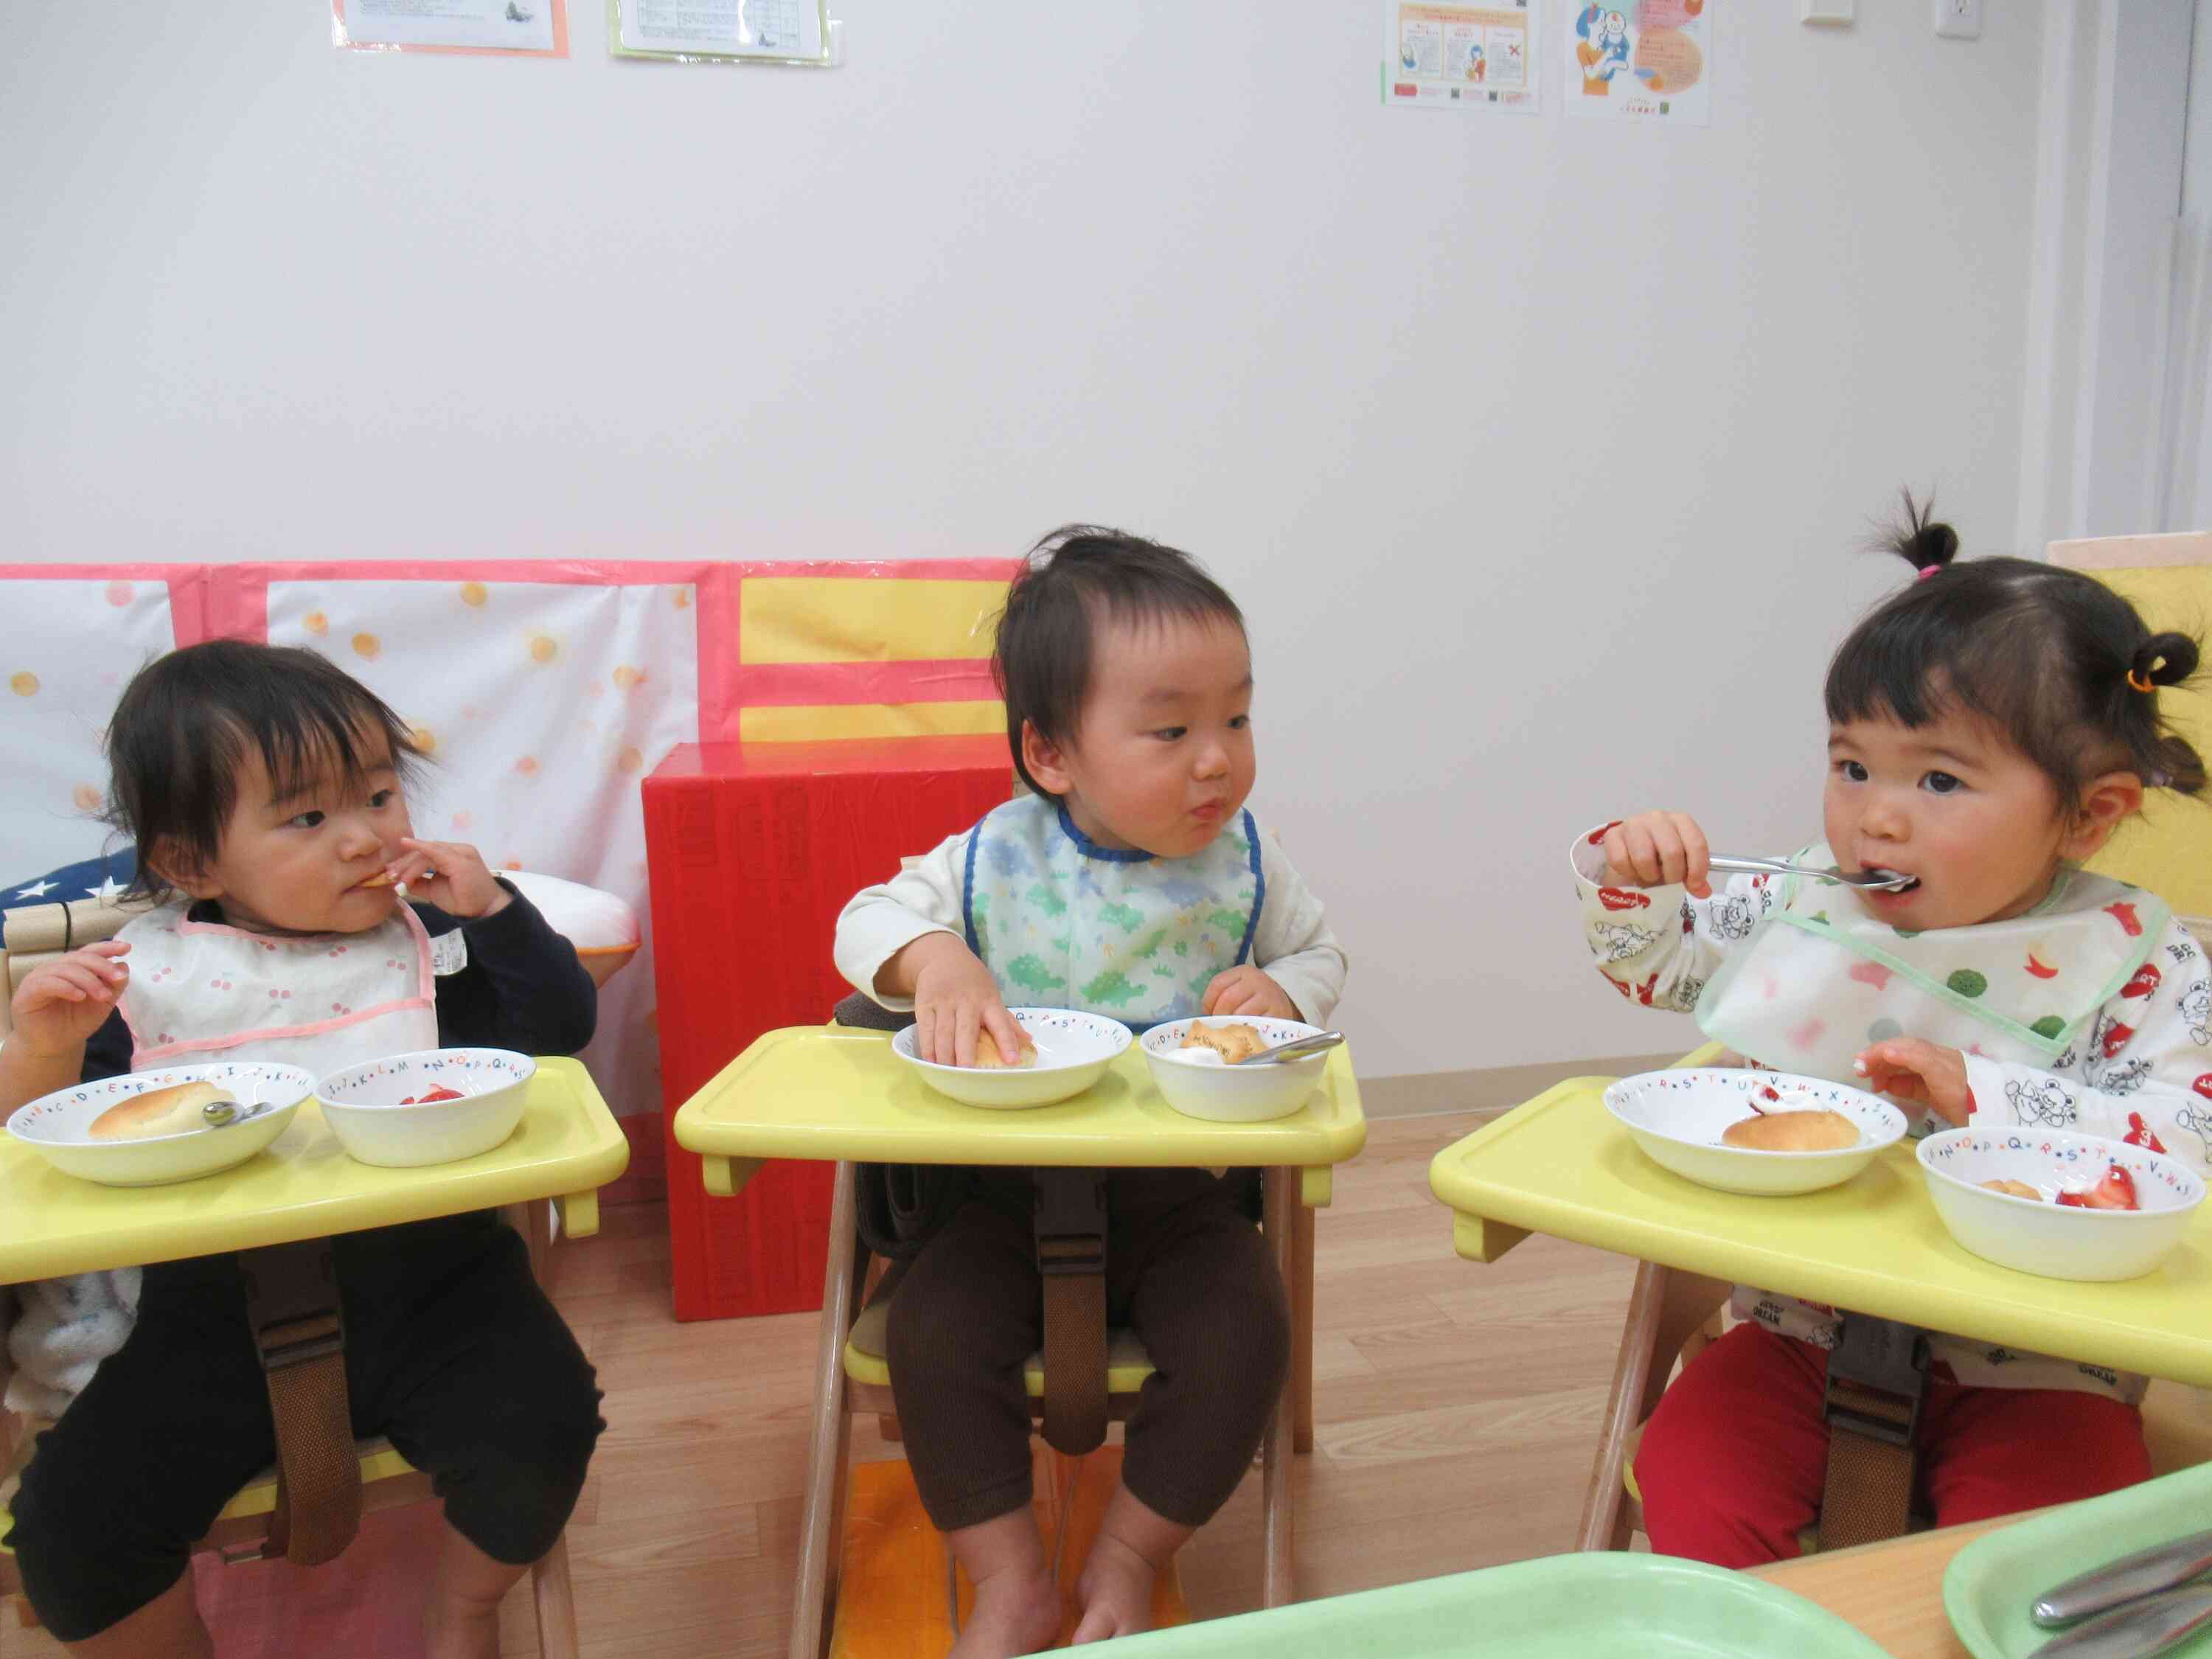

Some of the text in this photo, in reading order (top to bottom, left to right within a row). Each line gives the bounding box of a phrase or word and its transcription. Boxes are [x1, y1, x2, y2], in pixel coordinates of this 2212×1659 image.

[359, 1074, 367, 1085] K
[432, 1059, 445, 1071] N
[493, 1058, 502, 1068] Q
[76, 1092, 88, 1102] D
[108, 1083, 116, 1093] E
[136, 1082, 146, 1093] F
[1683, 1079, 1691, 1089] S
[1770, 1076, 1779, 1085] V
[1829, 1091, 1838, 1102] X
[1963, 1136, 1971, 1147] O
[2008, 1136, 2023, 1150] Q
[2041, 1142, 2051, 1155] R
[2067, 1150, 2077, 1161] S
[2150, 1160, 2159, 1173] V
